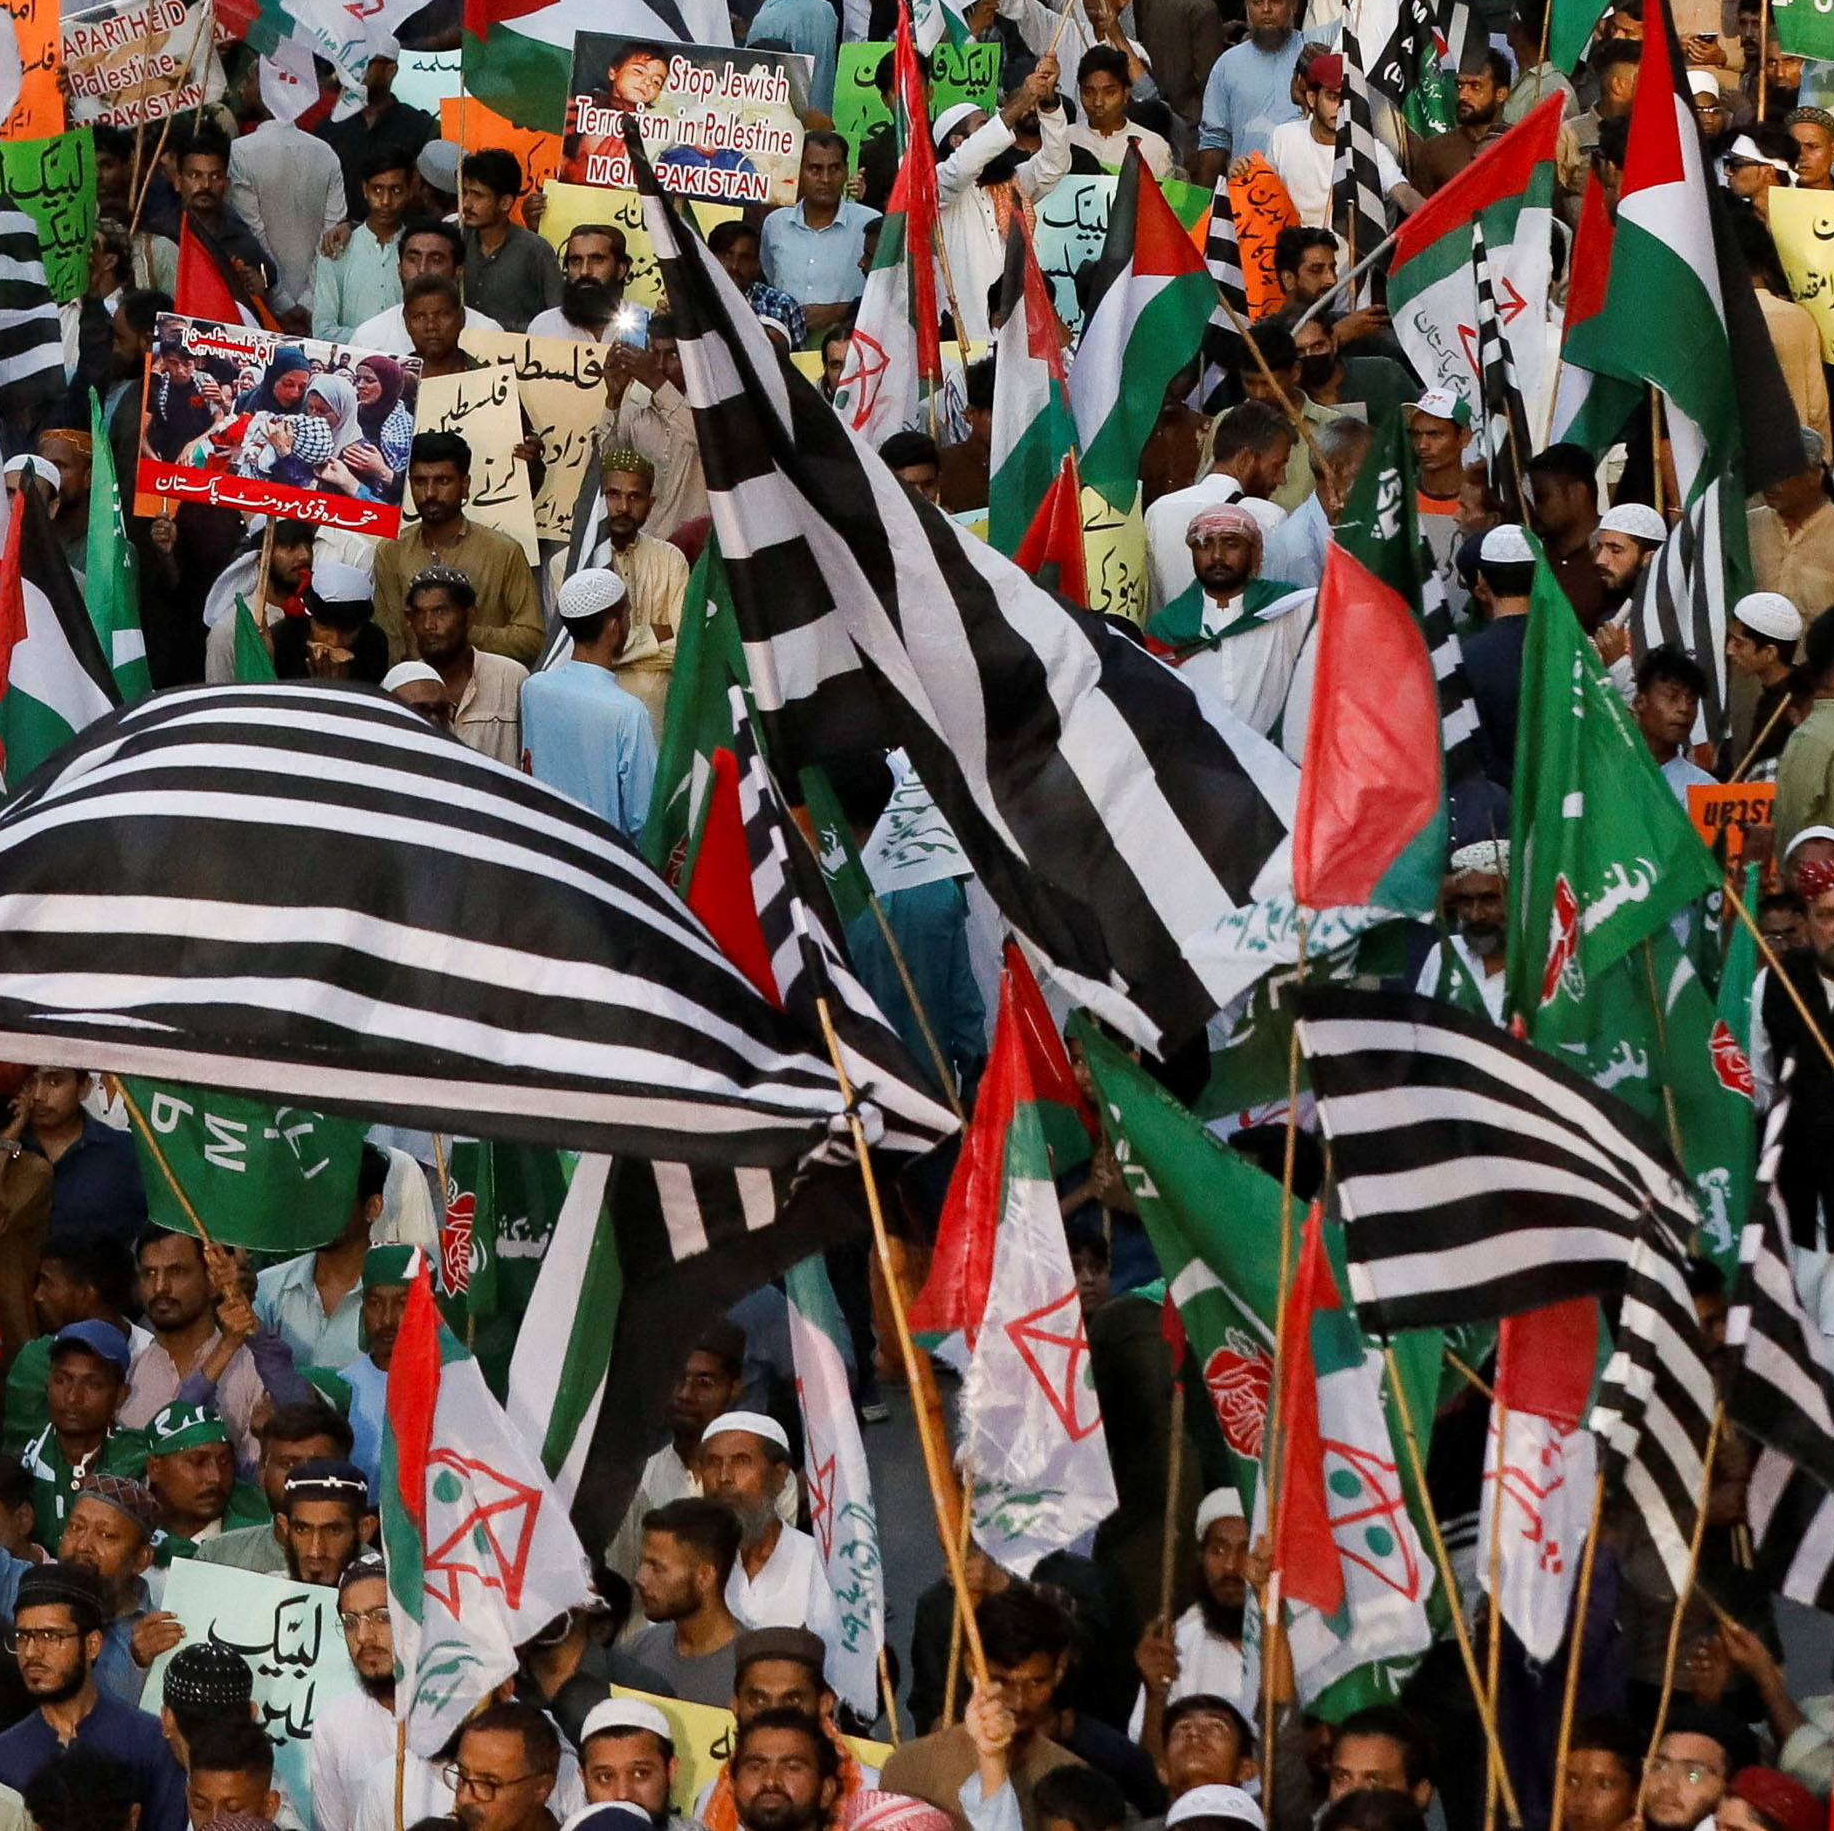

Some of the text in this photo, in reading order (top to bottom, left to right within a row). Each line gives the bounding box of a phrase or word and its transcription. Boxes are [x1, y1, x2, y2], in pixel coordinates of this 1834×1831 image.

[70, 52, 177, 99] Palestine
[668, 53, 789, 105] Stop Jewish
[677, 110, 697, 141] in
[702, 110, 794, 155] Palestine
[655, 163, 770, 201] PAKISTAN
[154, 474, 378, 528] متحدہ قومی موومنٹ پاکستان
